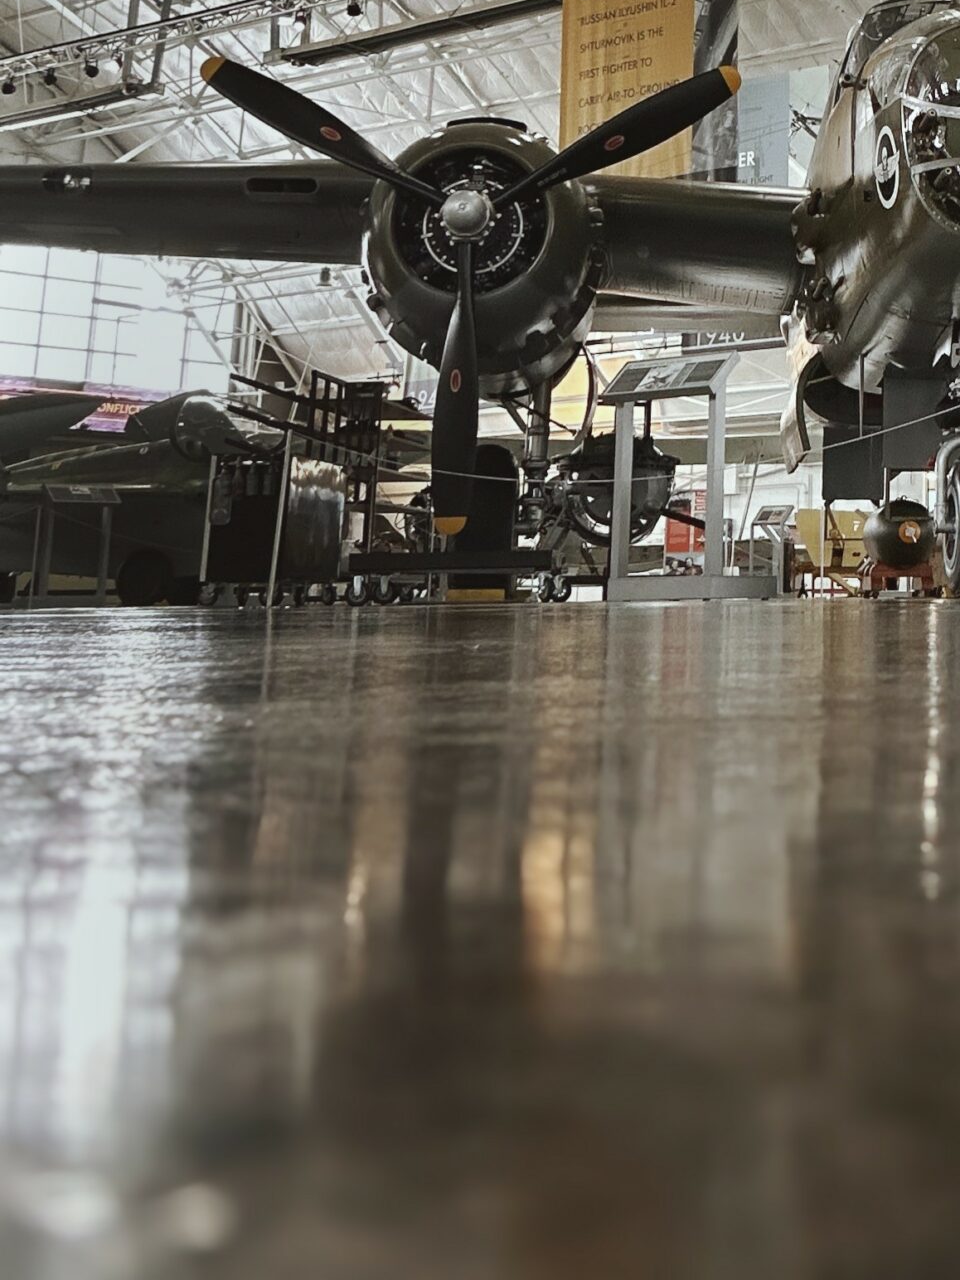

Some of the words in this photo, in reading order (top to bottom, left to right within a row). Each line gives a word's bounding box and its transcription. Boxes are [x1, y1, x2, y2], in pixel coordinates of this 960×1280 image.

[618, 0, 658, 18] ILYUSHIN
[579, 34, 635, 54] SHTURMOVIK
[637, 31, 647, 42] IS
[648, 26, 665, 39] THE
[578, 68, 600, 82] FIRST
[602, 59, 639, 75] FIGHTER
[641, 56, 653, 68] TO
